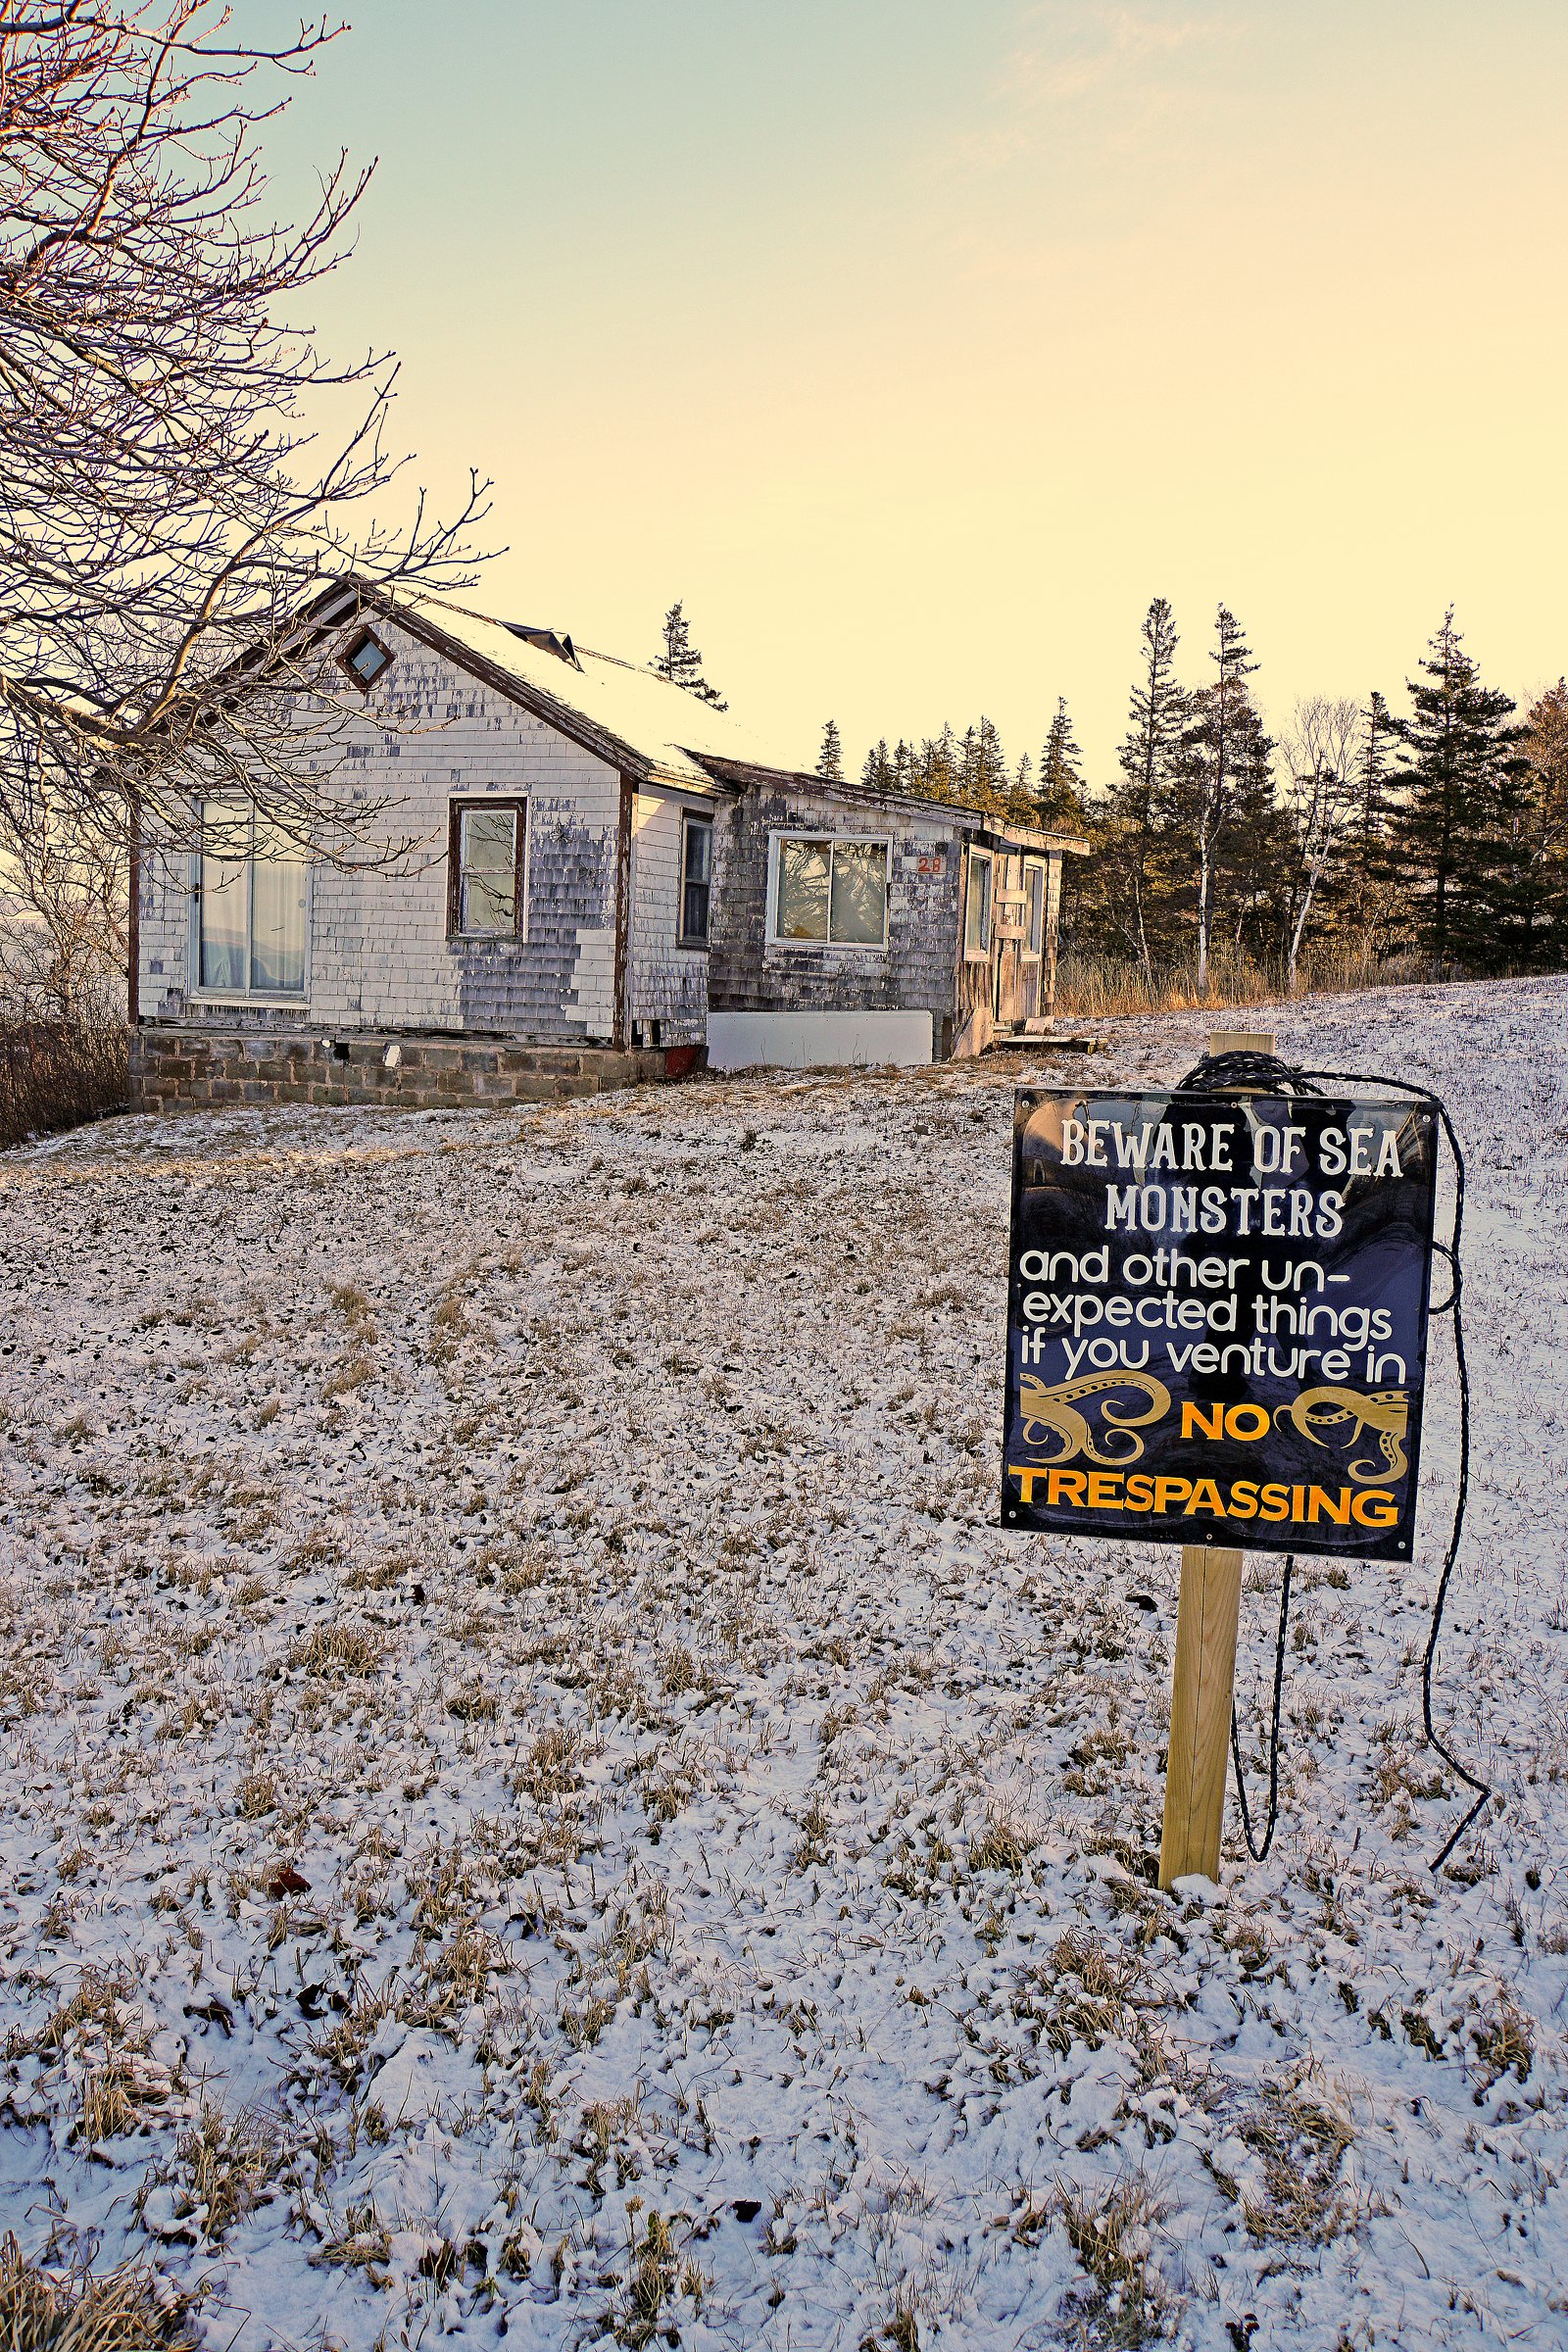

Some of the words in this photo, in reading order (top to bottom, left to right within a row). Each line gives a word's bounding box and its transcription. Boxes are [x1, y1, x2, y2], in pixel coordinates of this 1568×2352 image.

[1060, 1119, 1235, 1172] BEWARE
[1253, 1126, 1306, 1174] OF
[1319, 1127, 1403, 1178] SEA
[1104, 1184, 1346, 1238] MONSTERS
[1020, 1246, 1108, 1284] and
[1123, 1249, 1250, 1289] other
[1261, 1259, 1349, 1293] un-
[1023, 1291, 1237, 1336] expected
[1251, 1296, 1392, 1352] things
[1021, 1326, 1046, 1364] if
[1062, 1337, 1150, 1380] you
[1166, 1342, 1350, 1380] venture
[1366, 1347, 1405, 1384] in
[1180, 1402, 1270, 1441] NO
[1008, 1464, 1398, 1527] TRESPASSING
